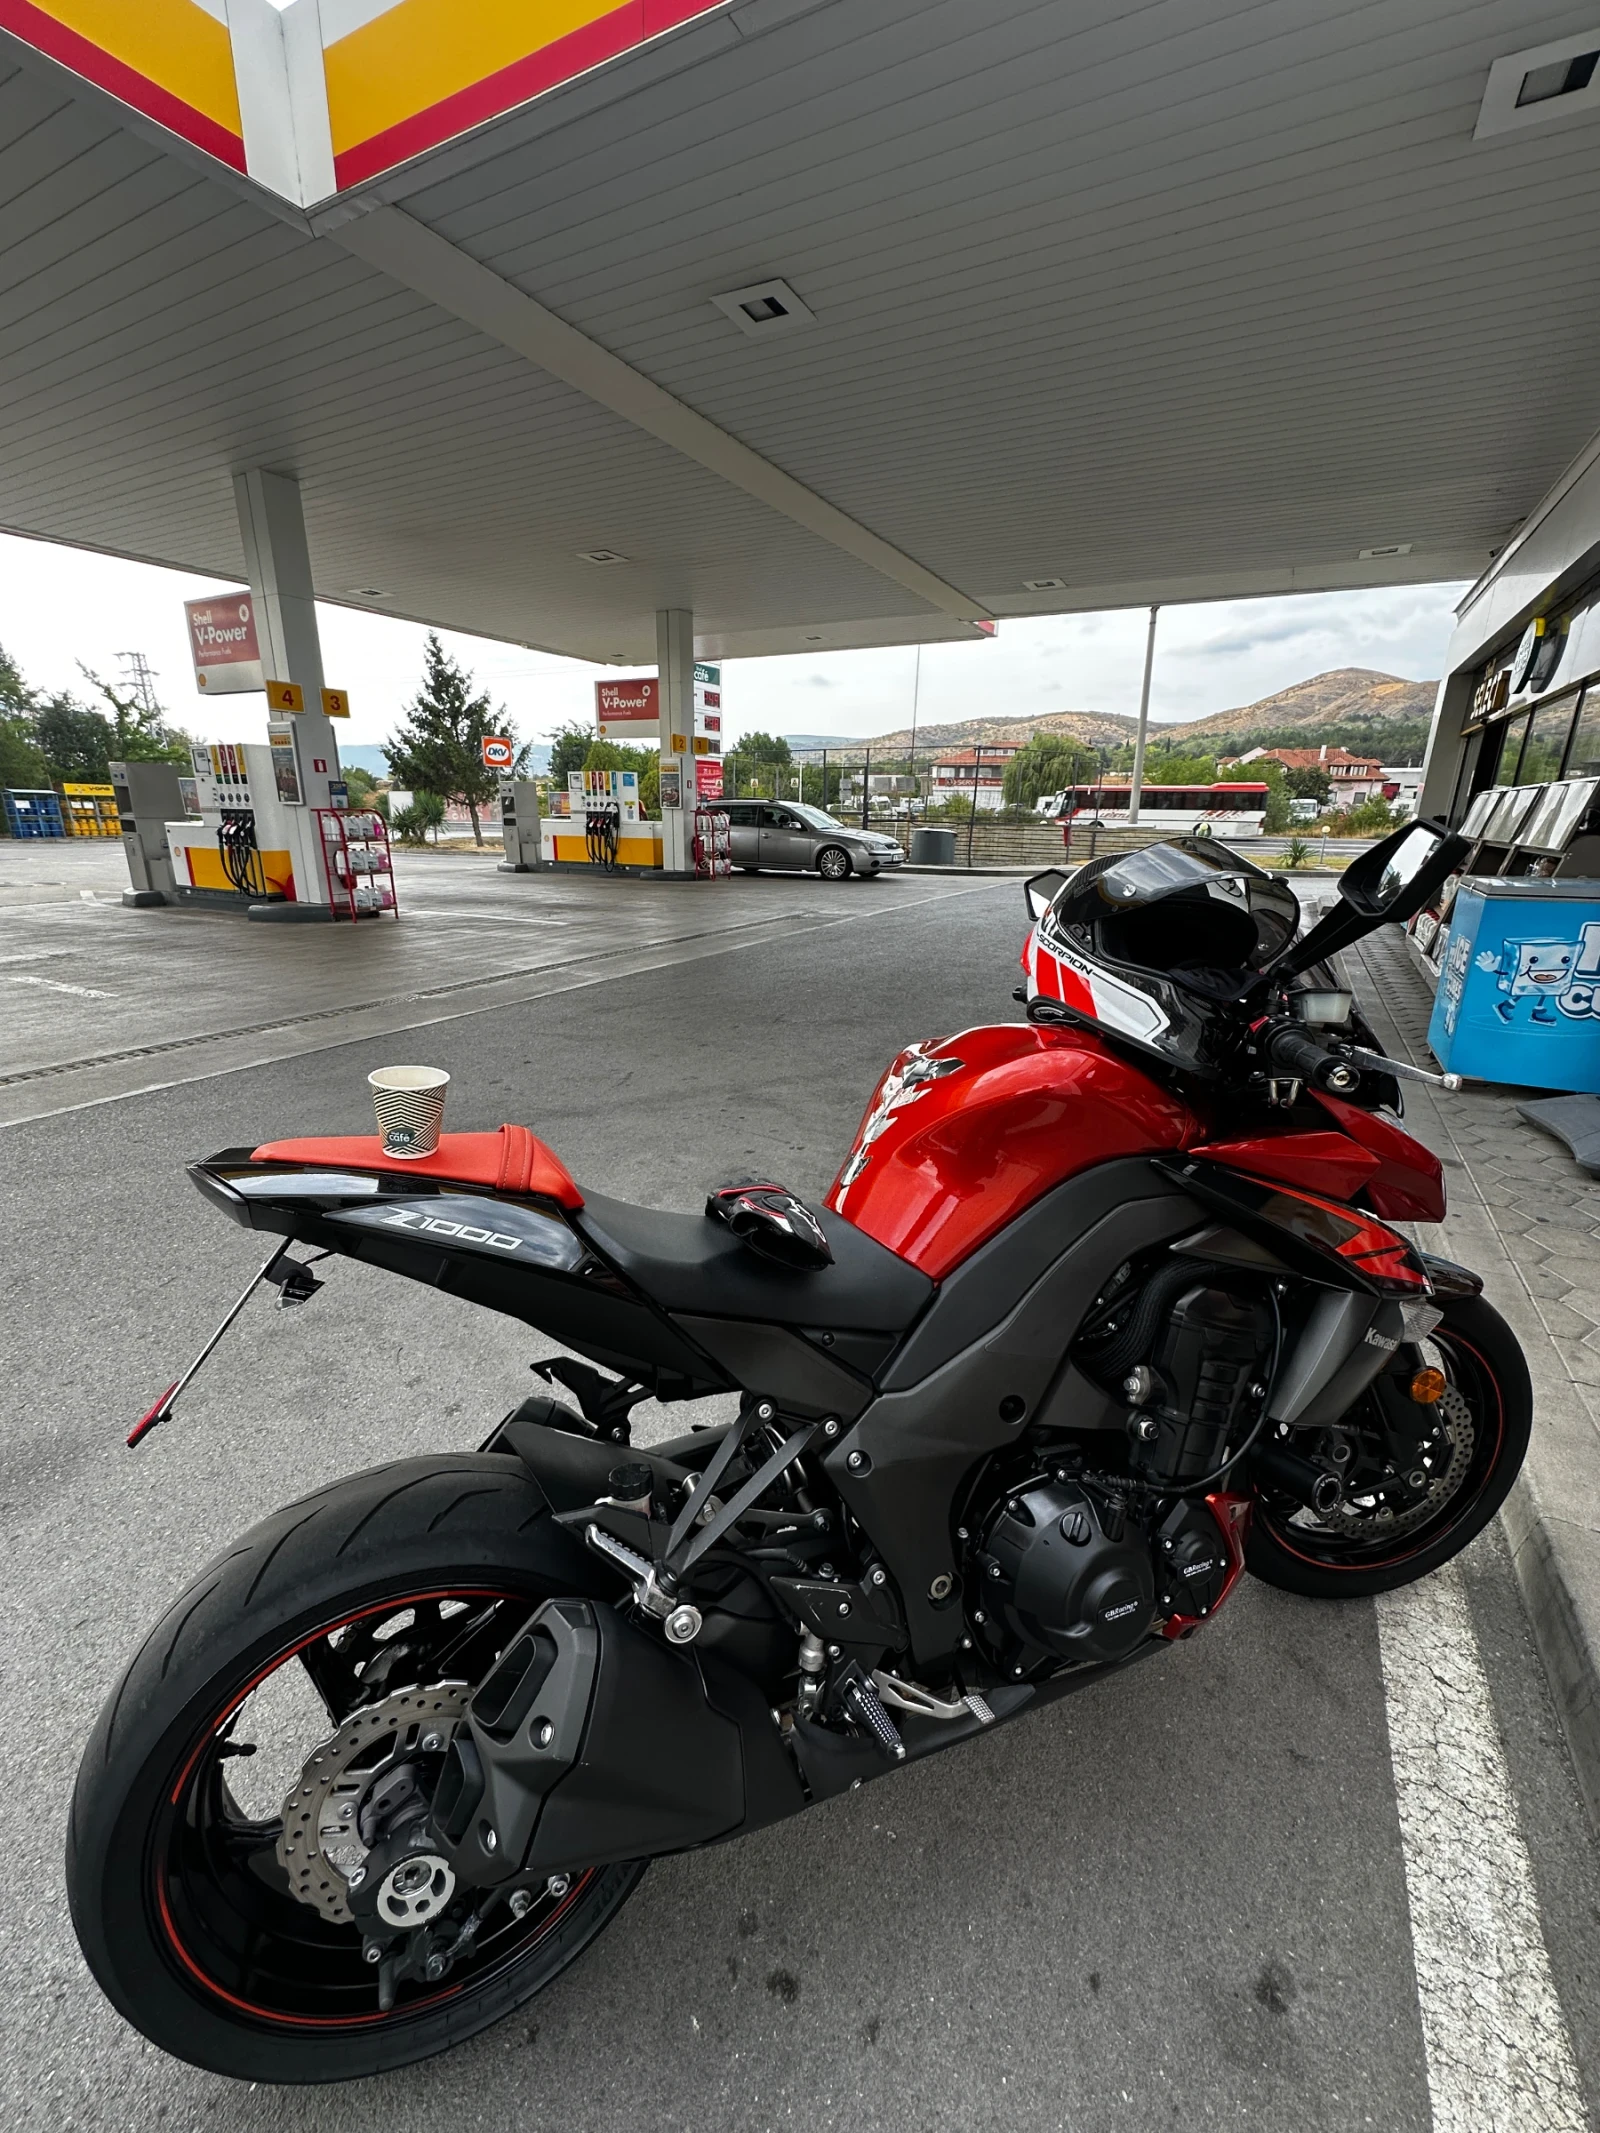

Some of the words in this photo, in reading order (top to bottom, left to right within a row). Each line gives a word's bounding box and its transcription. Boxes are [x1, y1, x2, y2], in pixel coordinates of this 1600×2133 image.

[193, 610, 212, 626] Shell
[195, 626, 247, 646] V-Power
[282, 690, 294, 706] 4
[601, 687, 618, 696] Shell
[330, 695, 341, 711] 3
[602, 697, 647, 709] V-Power
[487, 747, 507, 757] DKV
[679, 739, 684, 749] 2
[697, 740, 702, 750] 1
[1038, 933, 1093, 976] SCORPION
[379, 1206, 523, 1250] Z1000
